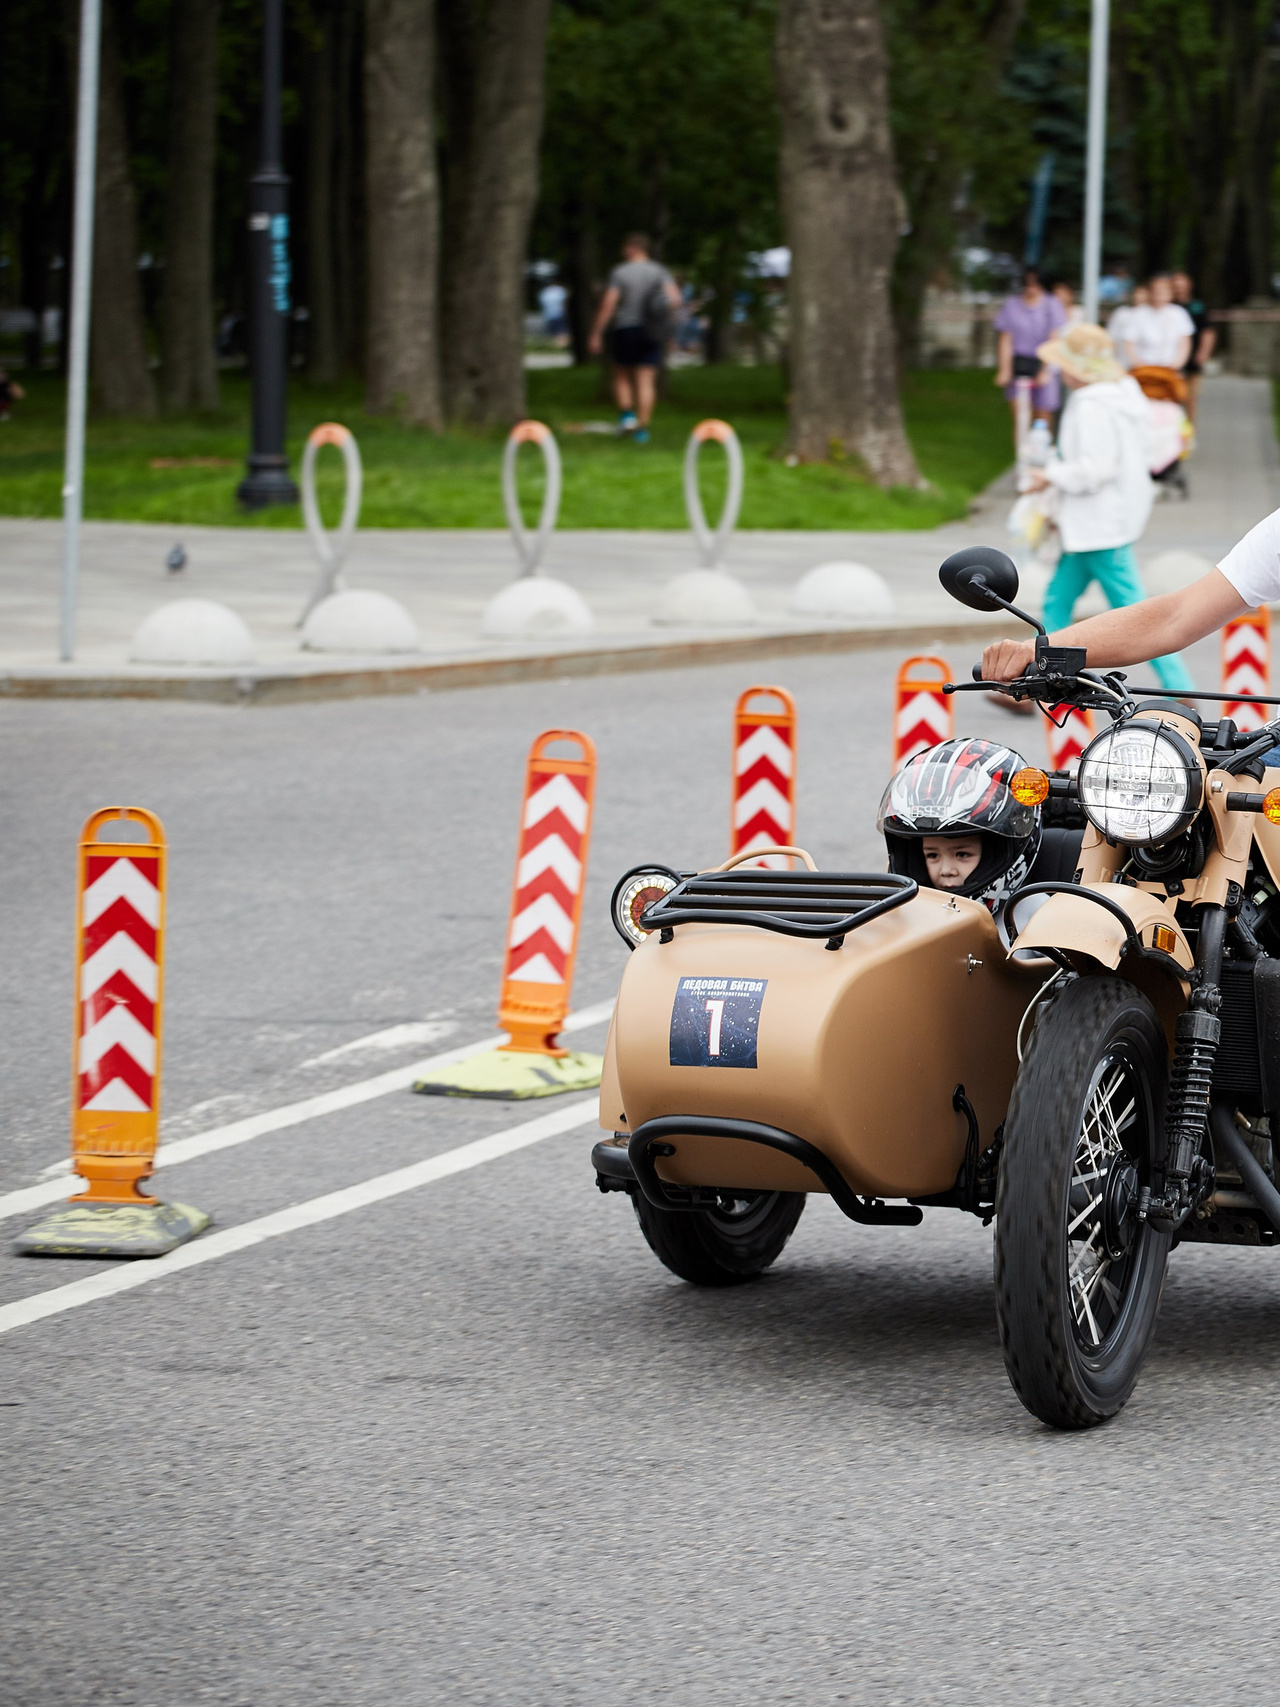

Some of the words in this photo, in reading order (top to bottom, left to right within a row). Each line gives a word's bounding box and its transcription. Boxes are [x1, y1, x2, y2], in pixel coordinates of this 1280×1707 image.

[682, 980, 728, 991] ЛЕДОВАЯ
[730, 981, 763, 993] БИТВА
[705, 999, 725, 1056] 1
